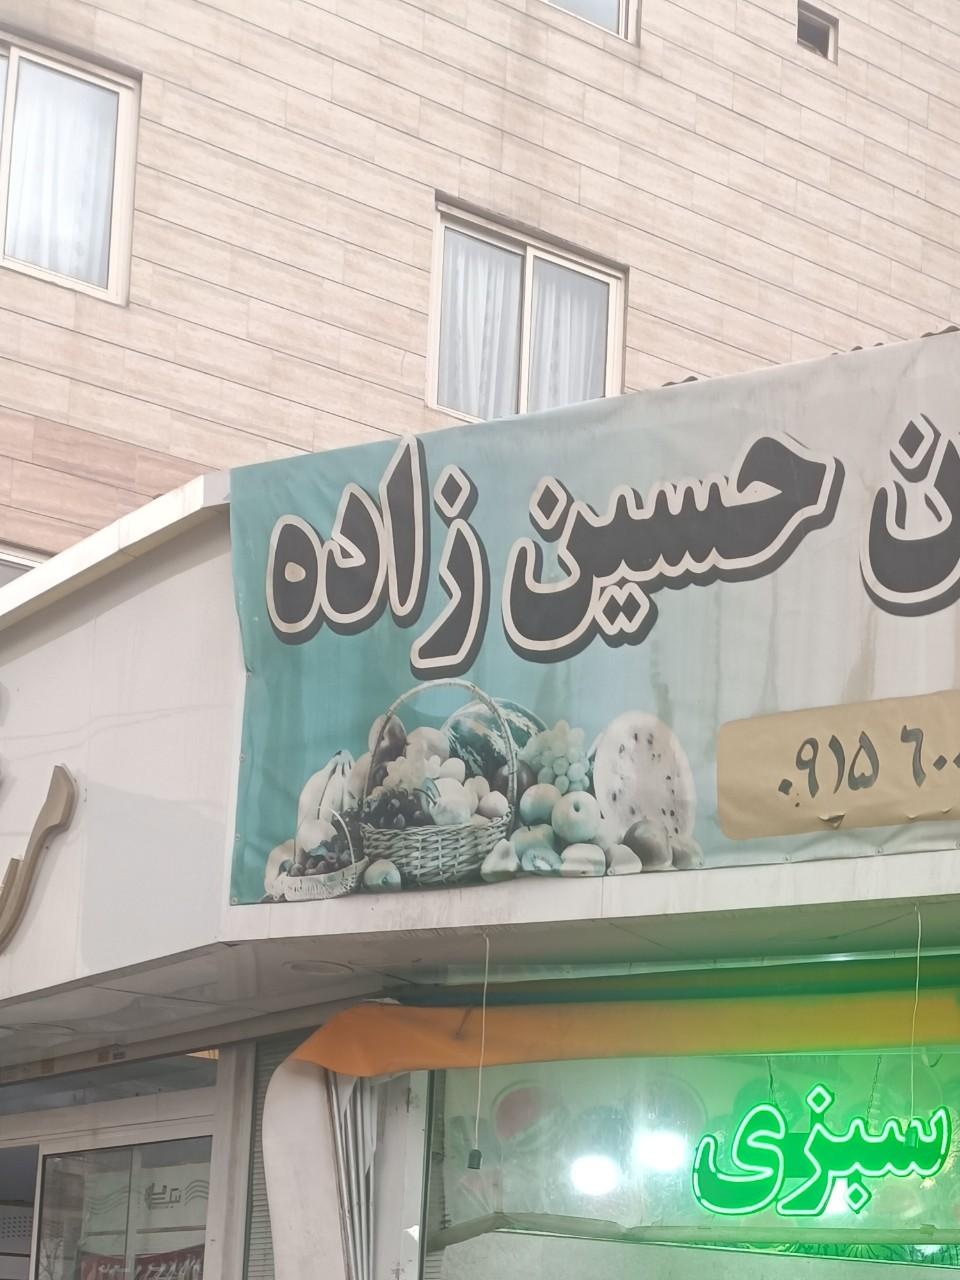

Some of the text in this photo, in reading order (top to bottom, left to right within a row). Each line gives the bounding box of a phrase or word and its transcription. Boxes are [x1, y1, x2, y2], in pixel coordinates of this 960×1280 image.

[265, 435, 490, 679] زاده
[501, 431, 845, 664] حسین
[692, 1083, 952, 1216] سبزی
